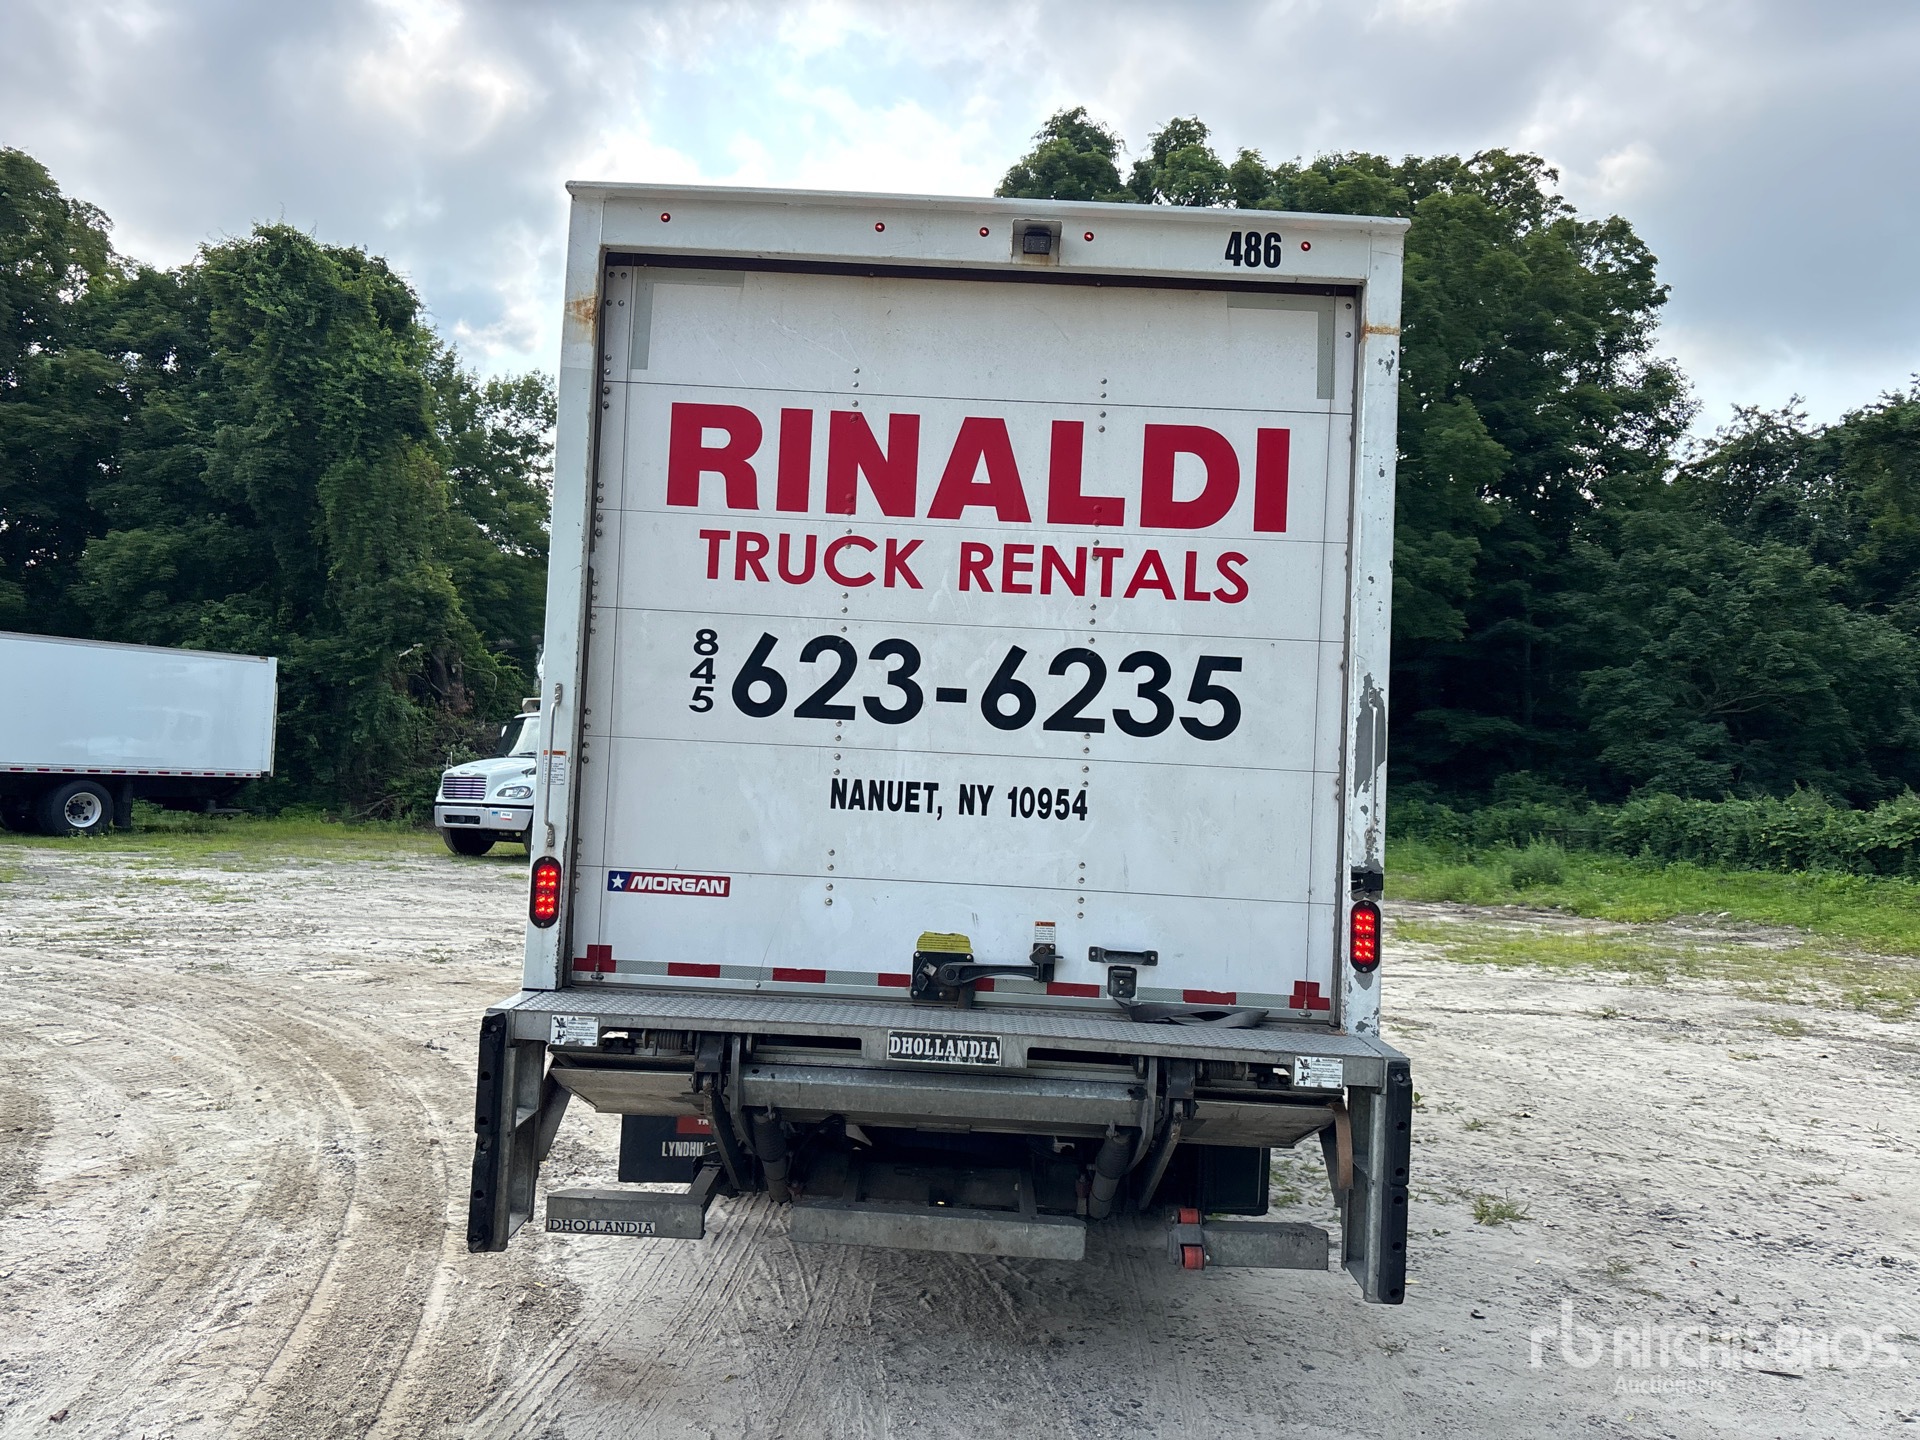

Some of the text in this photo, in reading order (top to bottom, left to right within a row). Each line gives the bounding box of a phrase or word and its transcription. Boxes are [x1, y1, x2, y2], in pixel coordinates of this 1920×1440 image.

[1224, 231, 1282, 269] 486
[666, 402, 1290, 533] RINALDI
[699, 529, 1249, 604] TRUCK RENTALS
[688, 628, 1243, 741] 845 623-6235
[830, 777, 1088, 821] NANUET, NY 10954
[630, 875, 726, 894] MORGAN
[889, 1036, 1000, 1059] DHOLLANDIA
[697, 1118, 710, 1126] TR
[661, 1140, 705, 1157] LYNDHU
[549, 1218, 654, 1234] DHOLLANDIA
